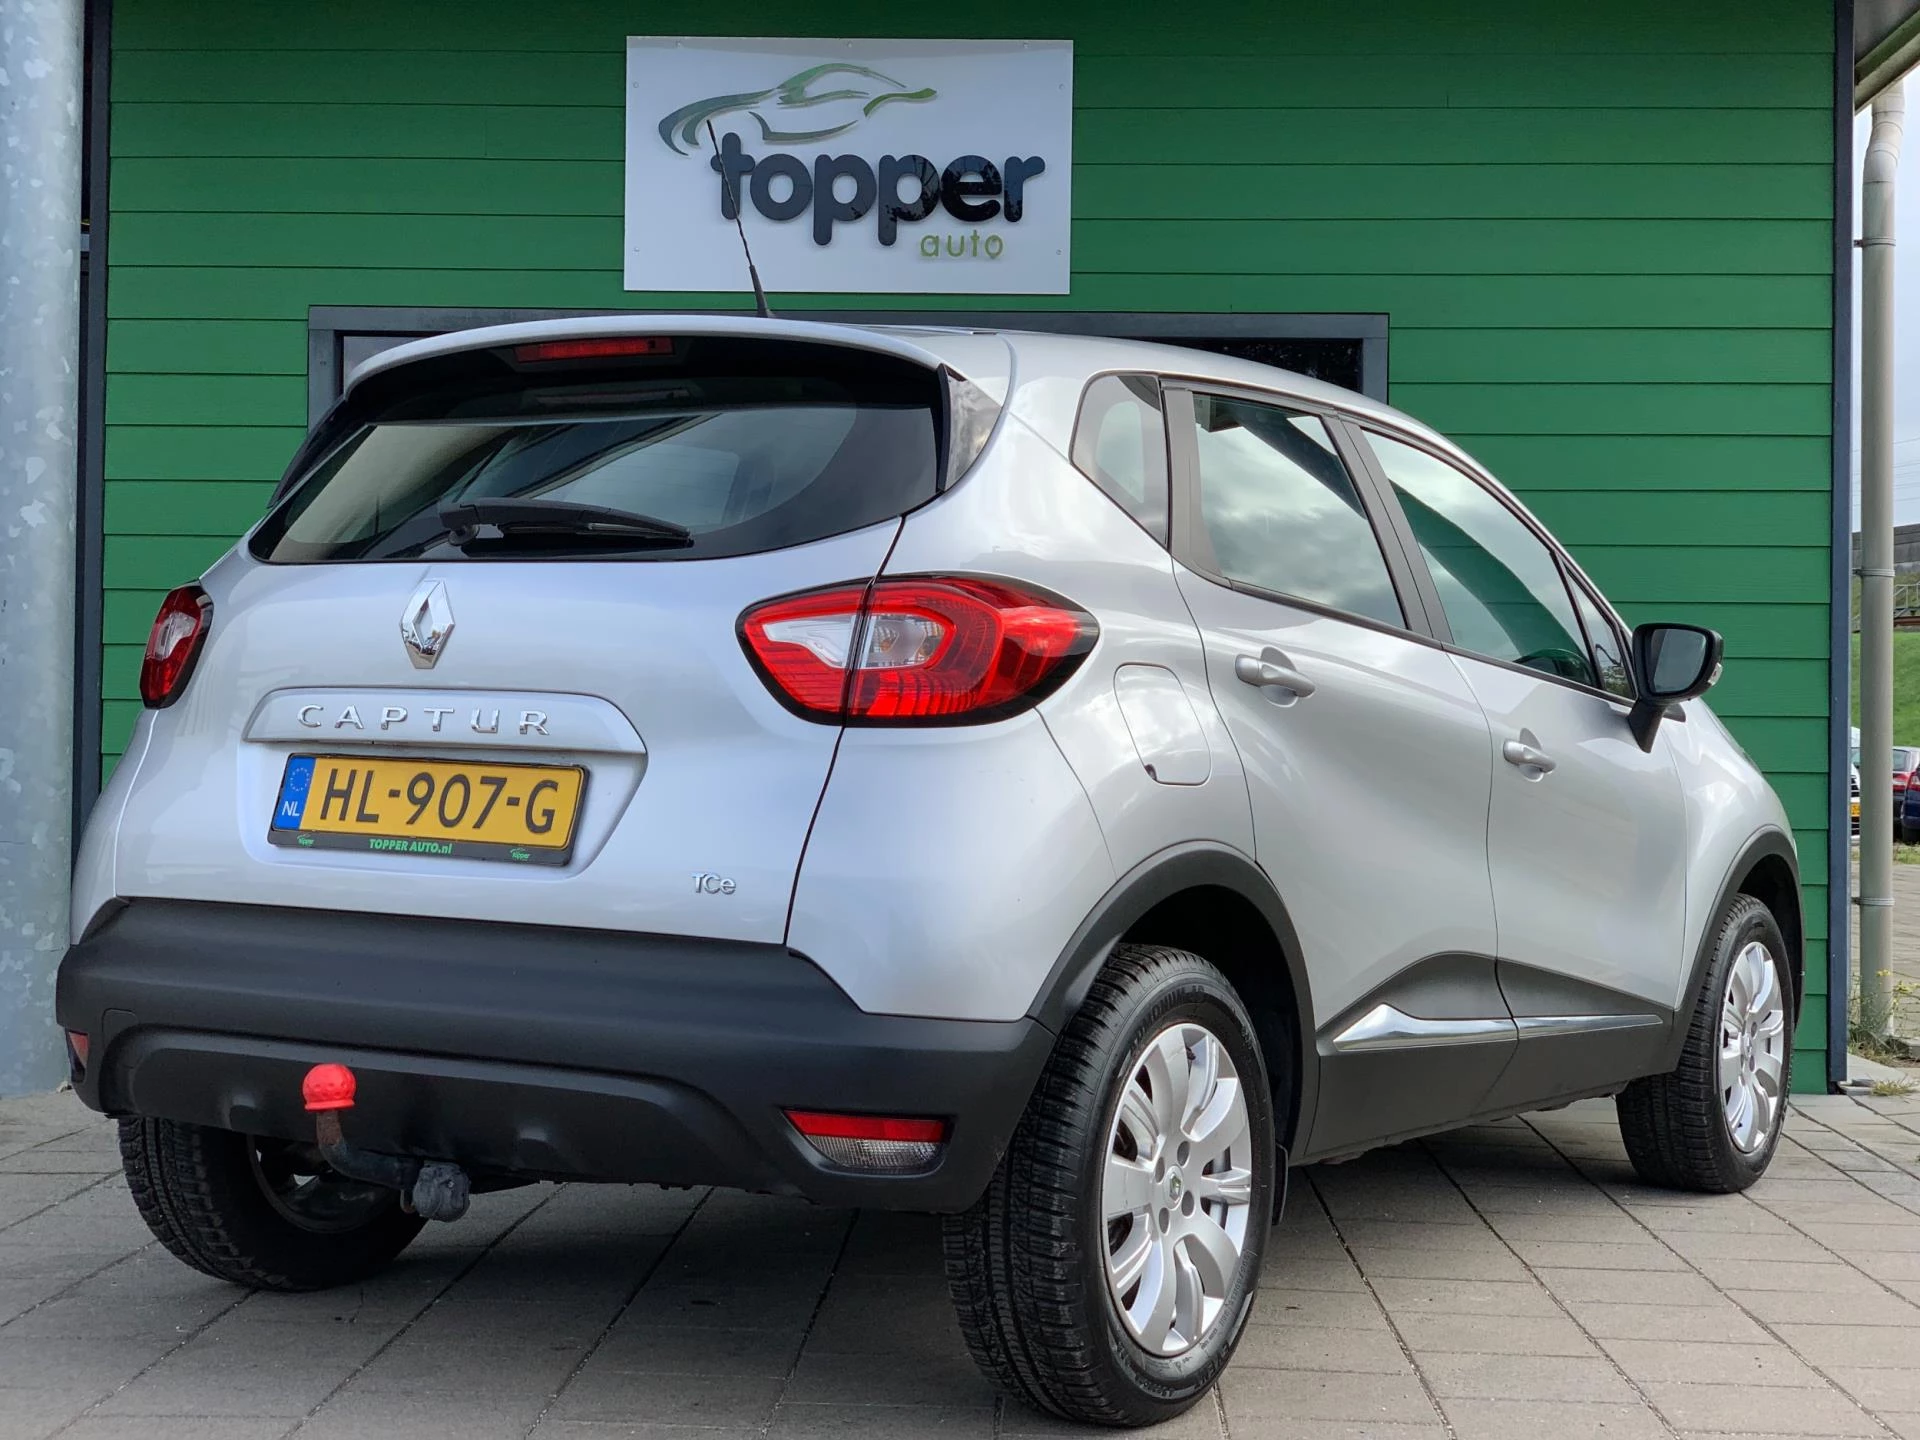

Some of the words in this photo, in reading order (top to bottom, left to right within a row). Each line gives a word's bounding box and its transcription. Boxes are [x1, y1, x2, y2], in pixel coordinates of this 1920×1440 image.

[710, 132, 1045, 246] topper
[920, 230, 1003, 257] auto
[297, 704, 549, 735] CAPTUR
[282, 801, 300, 816] NL
[320, 768, 559, 834] HL-907-G
[369, 838, 408, 851] TOPPER
[410, 842, 452, 854] AUTO.nl
[691, 872, 736, 895] TCe
